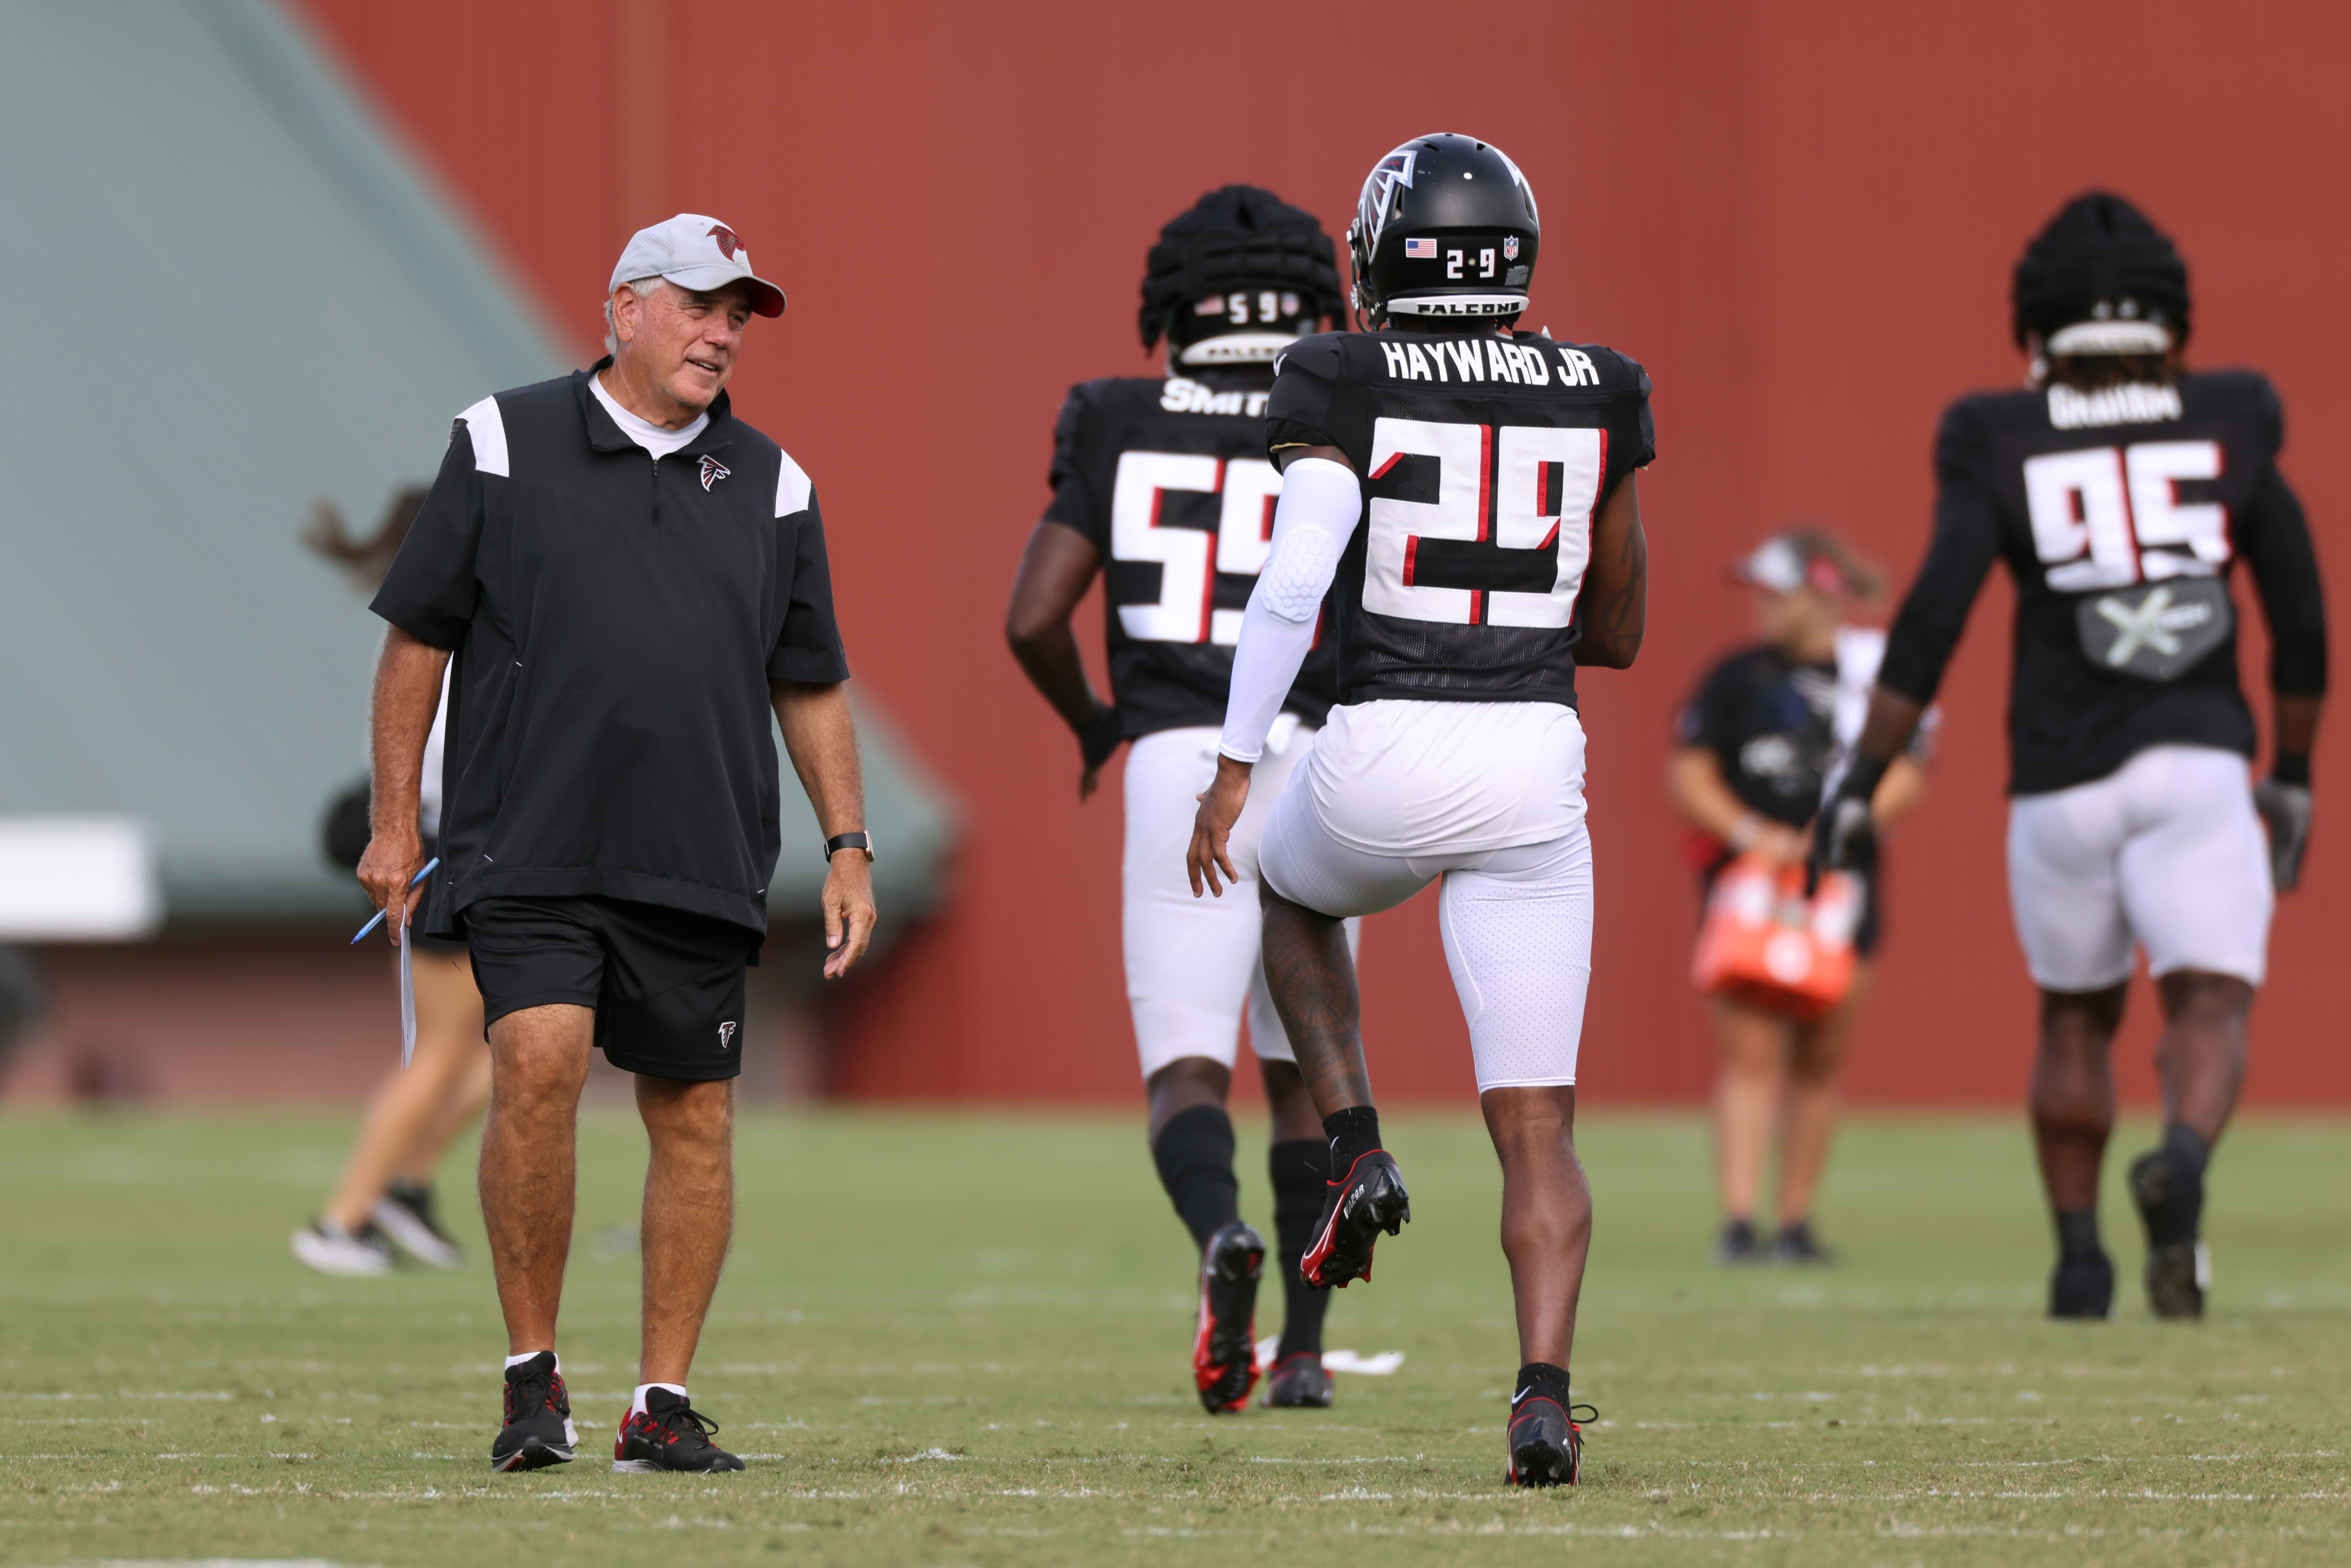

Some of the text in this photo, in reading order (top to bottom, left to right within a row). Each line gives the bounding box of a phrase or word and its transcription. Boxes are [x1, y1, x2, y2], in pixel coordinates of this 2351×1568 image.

[1506, 246, 1517, 257] NFL
[1417, 302, 1520, 314] FALCONS
[1380, 339, 1600, 386] HAYWARD JR
[1160, 376, 1270, 417] SMIT
[1362, 417, 1607, 628] 29
[2024, 441, 2233, 592] 95
[1343, 1184, 1365, 1220] VAPOR
